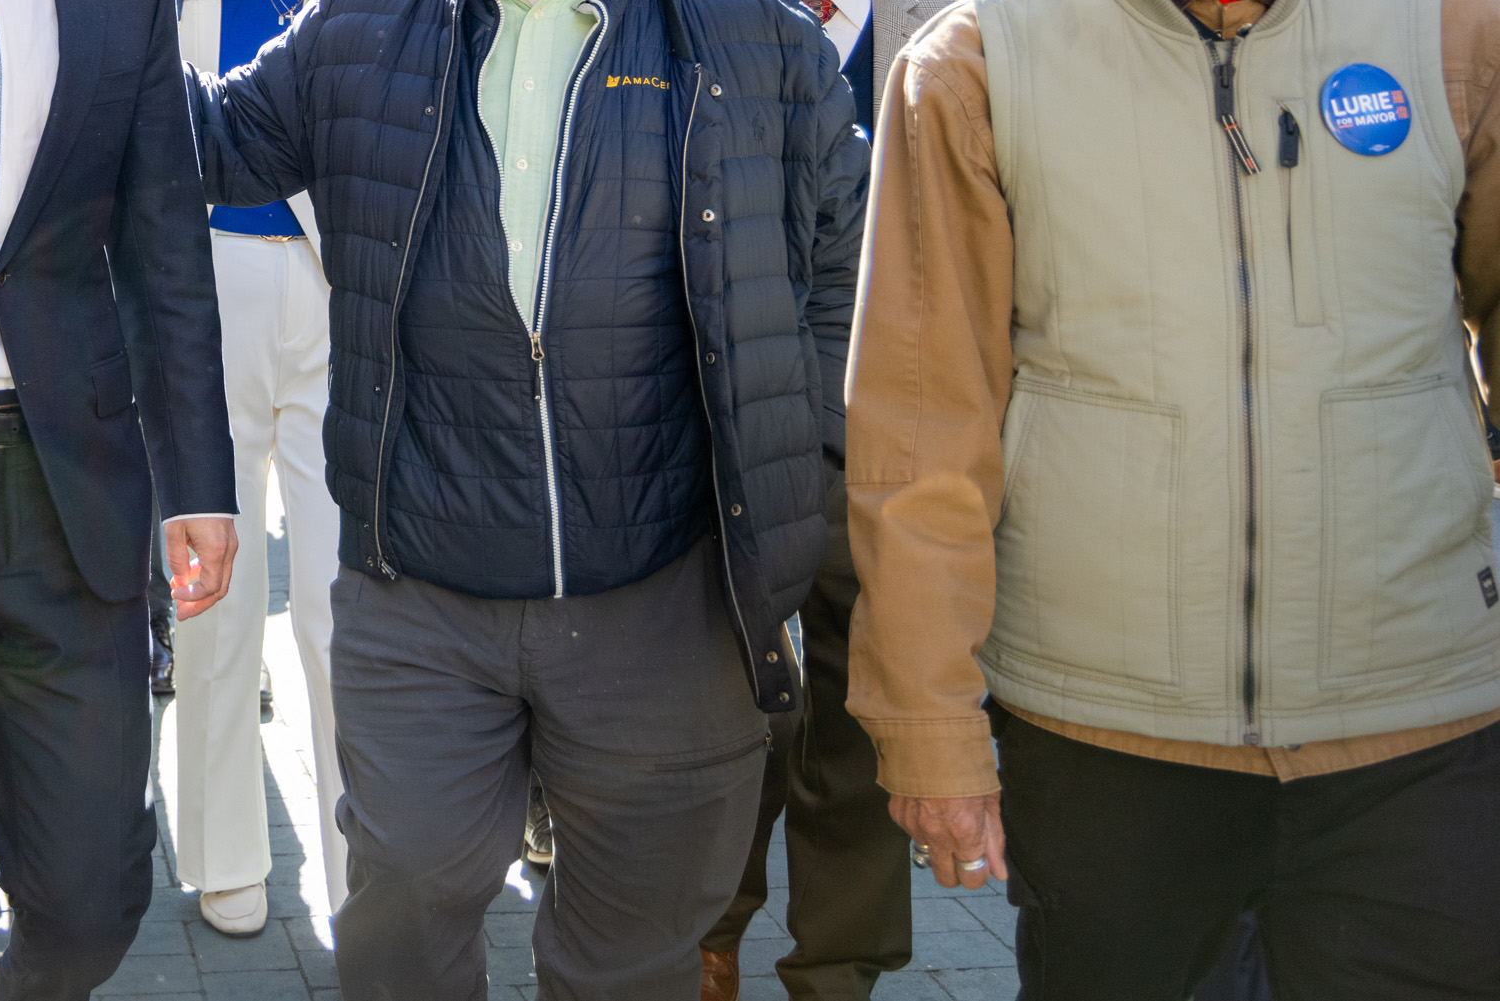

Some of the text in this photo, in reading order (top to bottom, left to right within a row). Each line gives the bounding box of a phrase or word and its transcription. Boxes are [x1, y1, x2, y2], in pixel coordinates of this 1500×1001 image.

[1331, 92, 1393, 117] LURIE
[1336, 111, 1396, 127] FOR MAYOR
